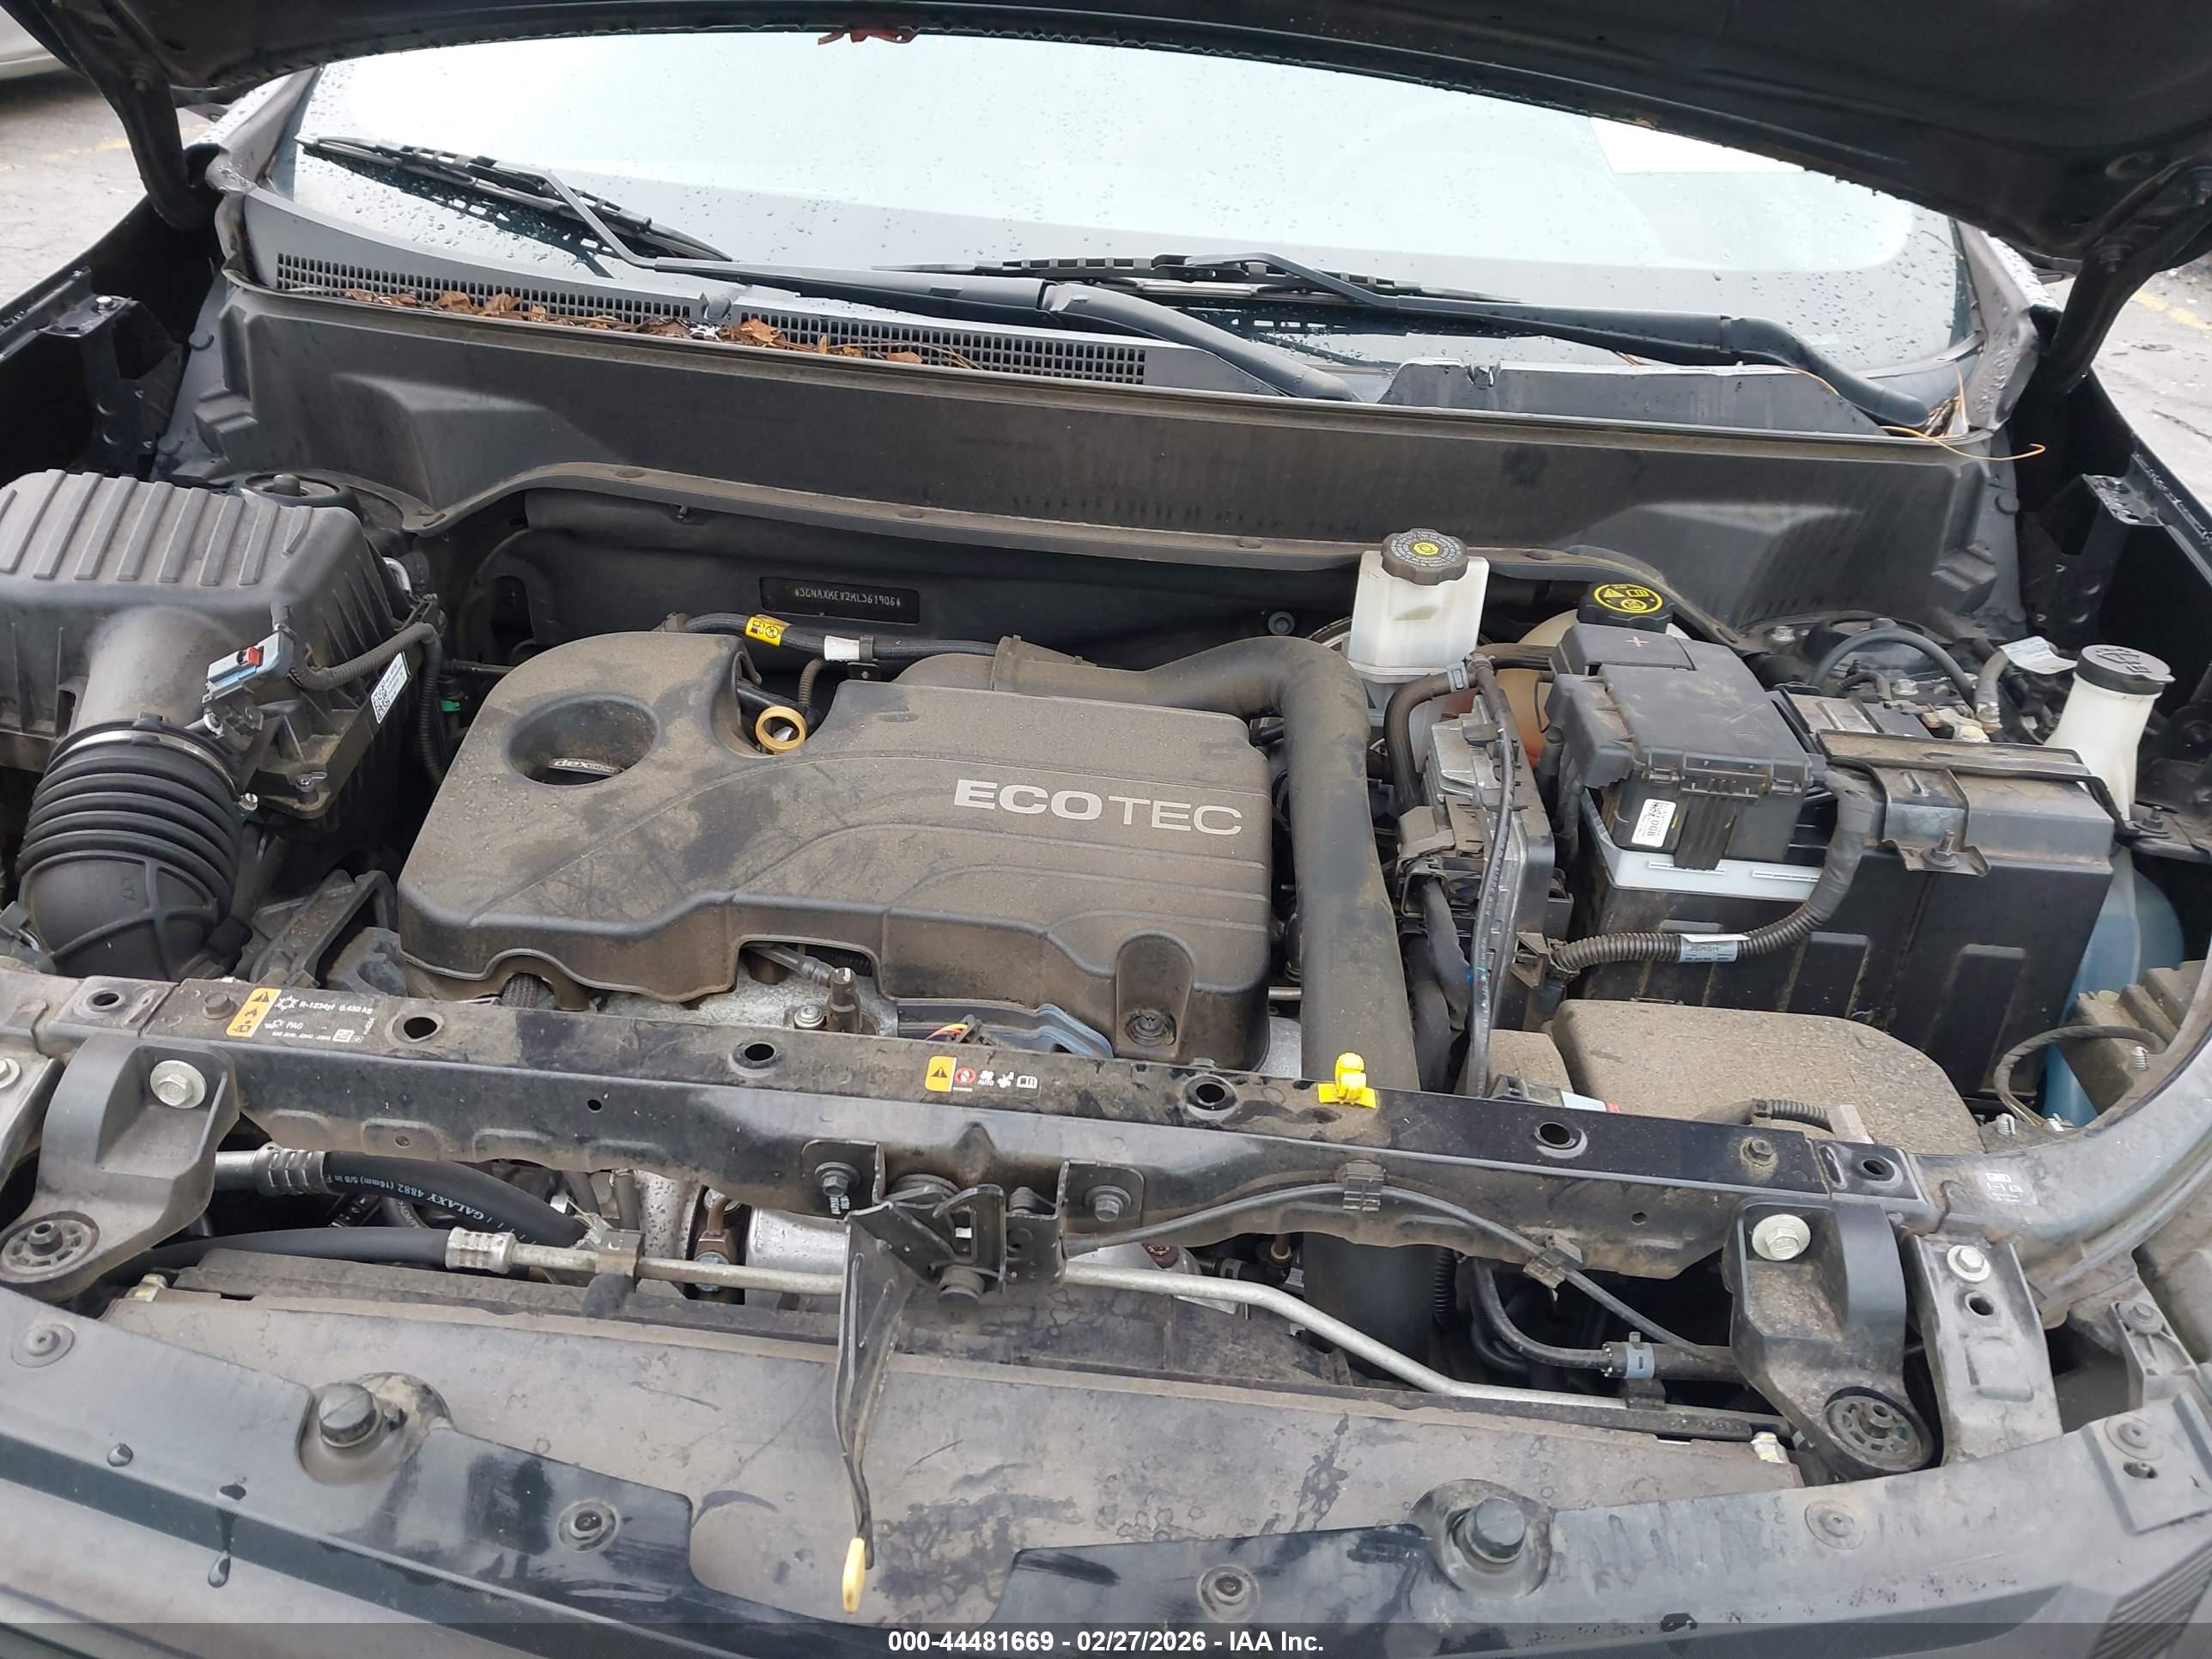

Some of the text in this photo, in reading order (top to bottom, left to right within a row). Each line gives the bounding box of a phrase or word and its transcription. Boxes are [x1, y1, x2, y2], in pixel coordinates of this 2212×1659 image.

[954, 780, 1242, 835] ECOTEC
[398, 1183, 424, 1197] 4882
[427, 1193, 484, 1221] GALAXY
